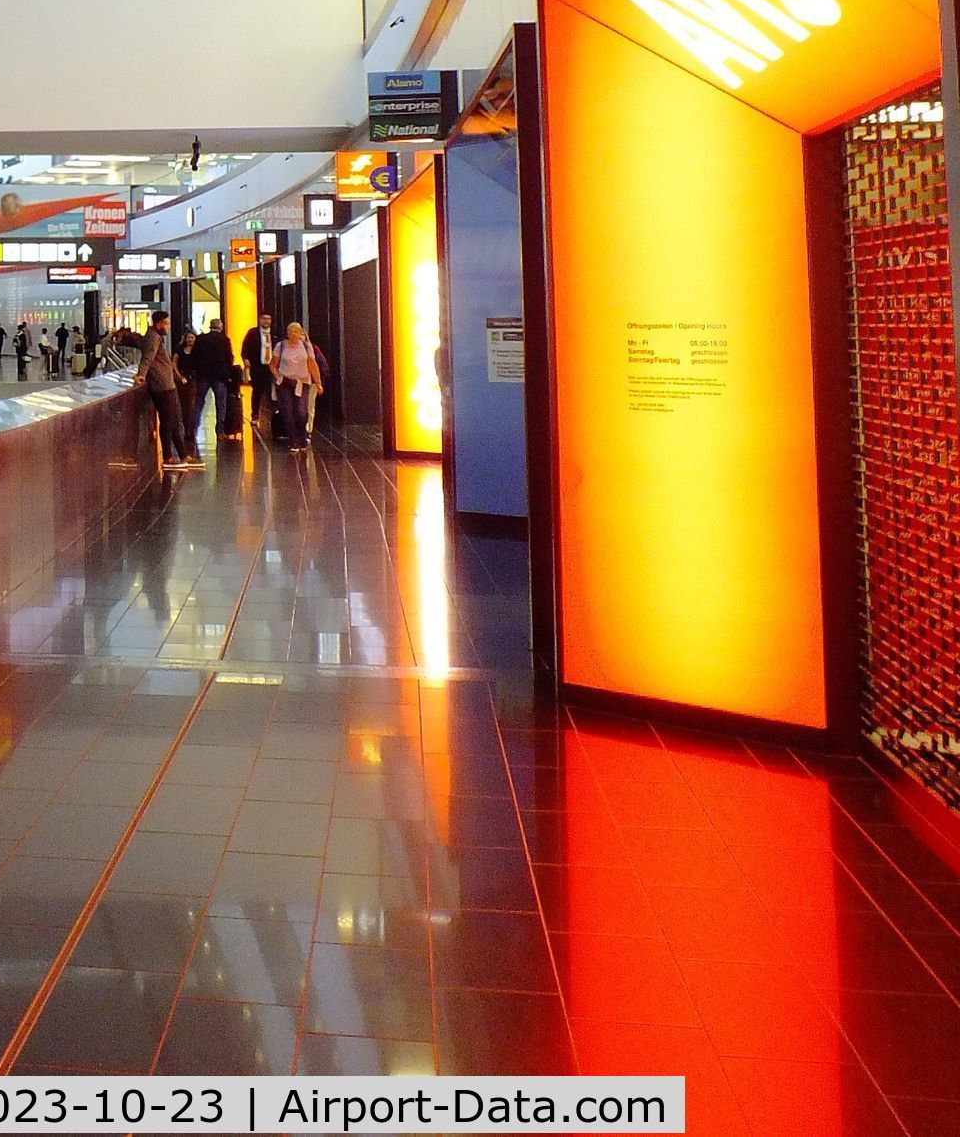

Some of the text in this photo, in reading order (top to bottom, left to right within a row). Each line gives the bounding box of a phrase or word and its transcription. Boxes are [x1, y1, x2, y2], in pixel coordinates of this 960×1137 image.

[386, 79, 424, 88] Alamo
[372, 101, 440, 112] enterprise
[388, 124, 439, 135] National
[84, 206, 126, 220] Kronen
[84, 220, 126, 236] Zeitung
